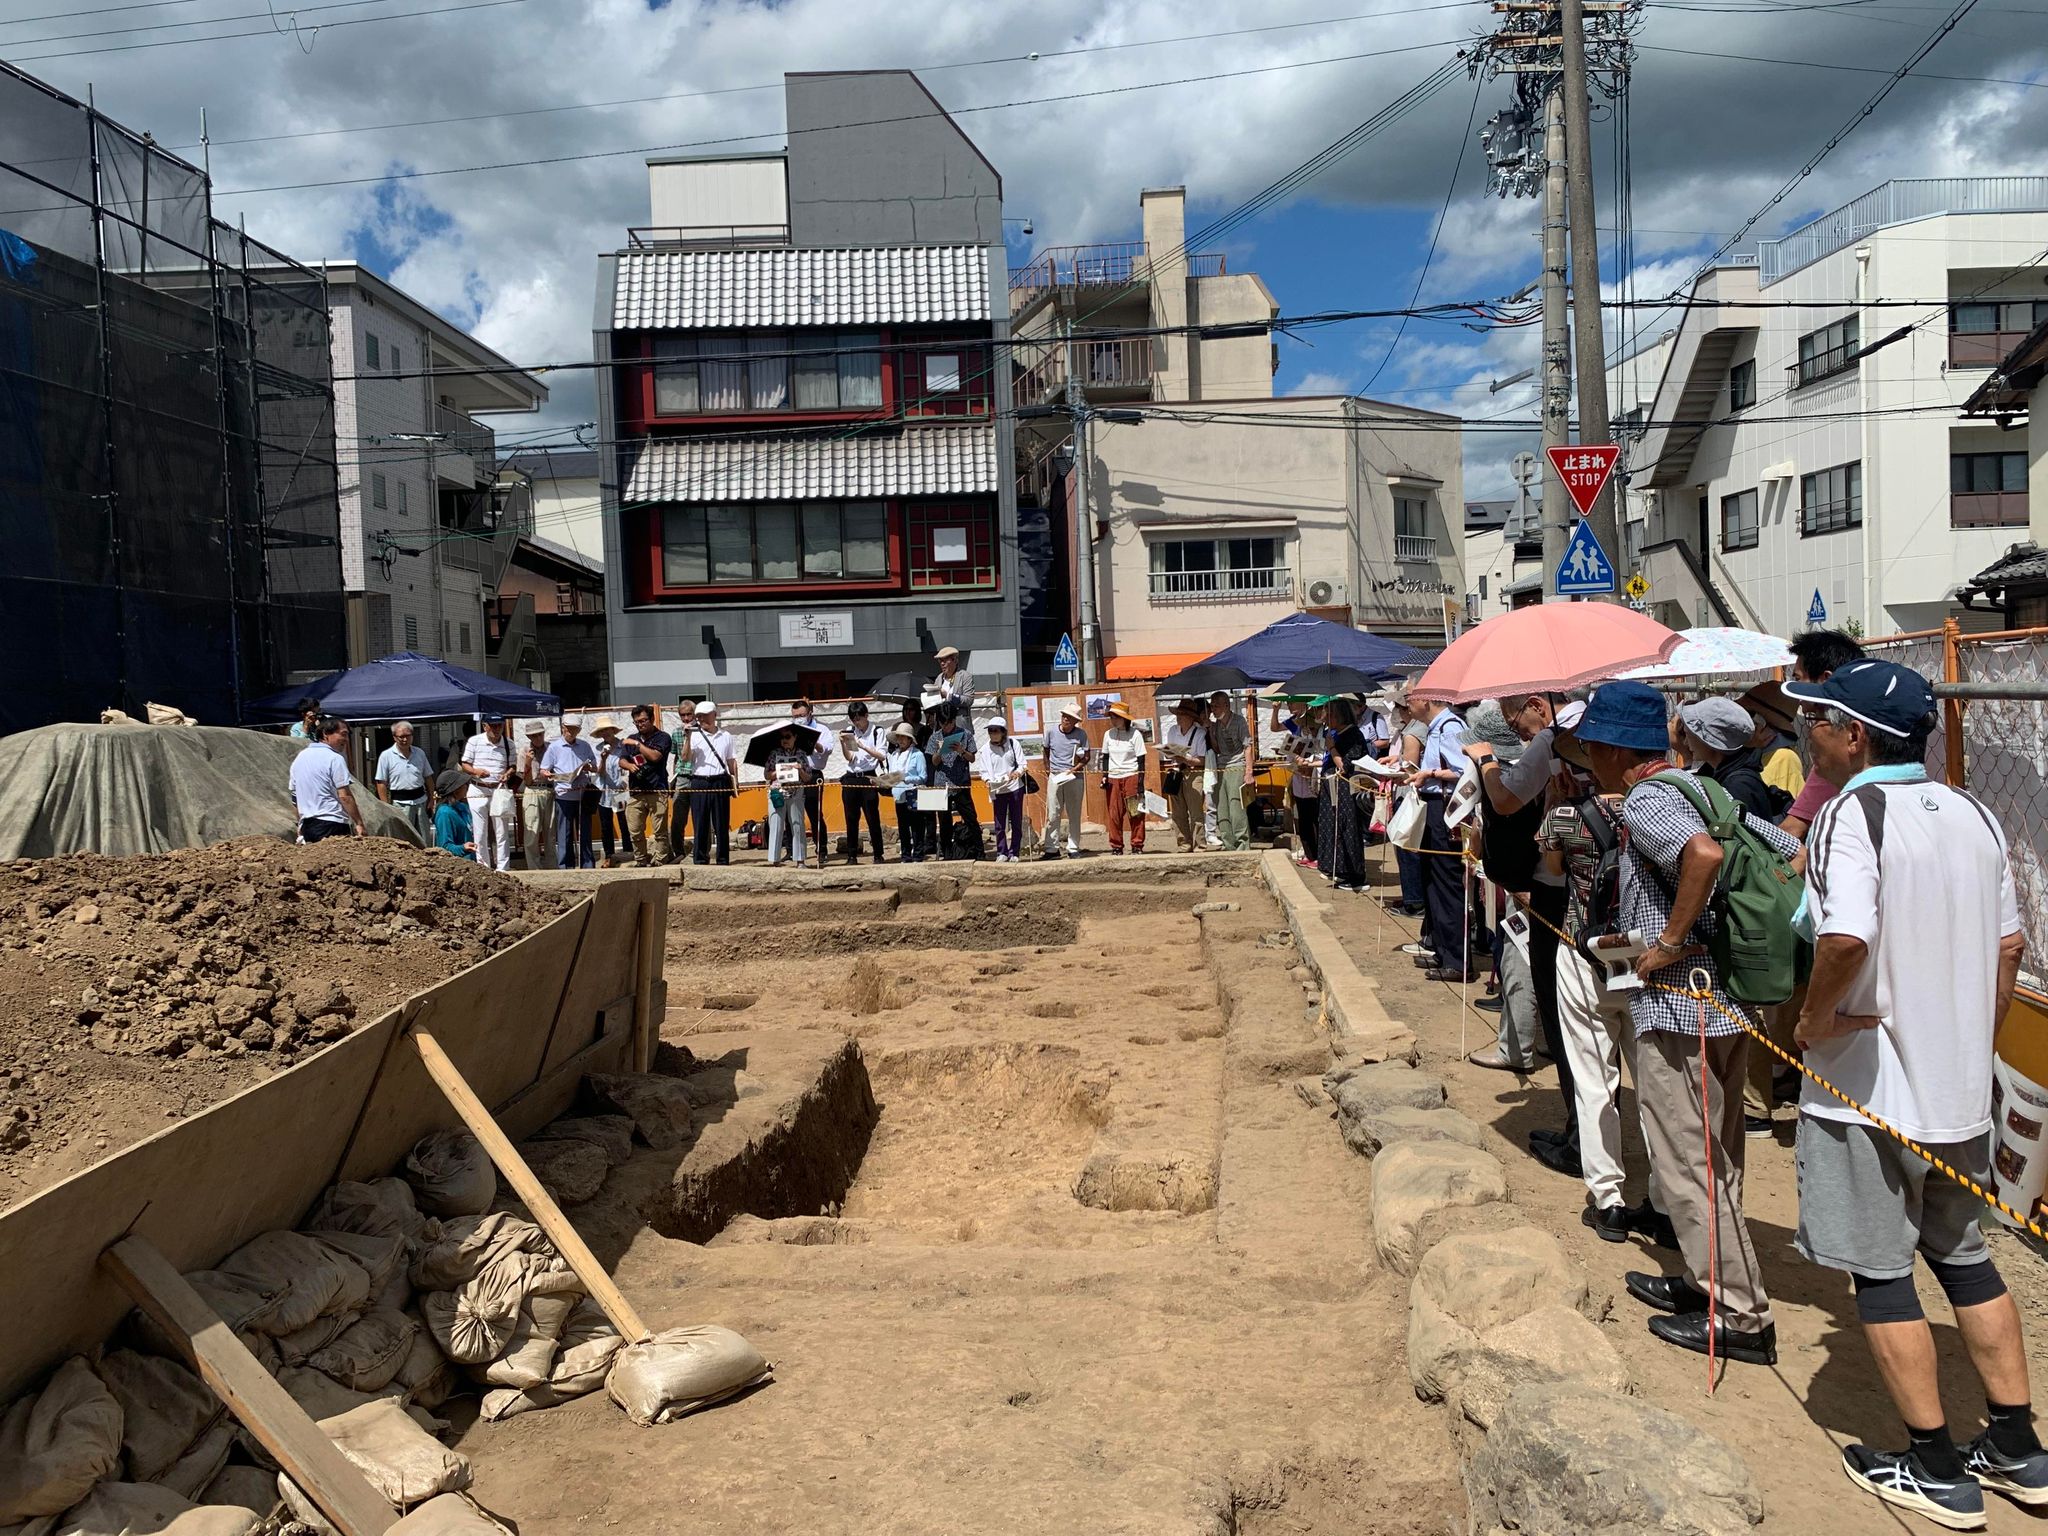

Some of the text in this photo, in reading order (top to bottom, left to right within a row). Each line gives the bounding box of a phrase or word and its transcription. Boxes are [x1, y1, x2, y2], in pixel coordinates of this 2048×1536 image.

[1563, 454, 1606, 470] 止まれ
[1571, 473, 1600, 486] STOP
